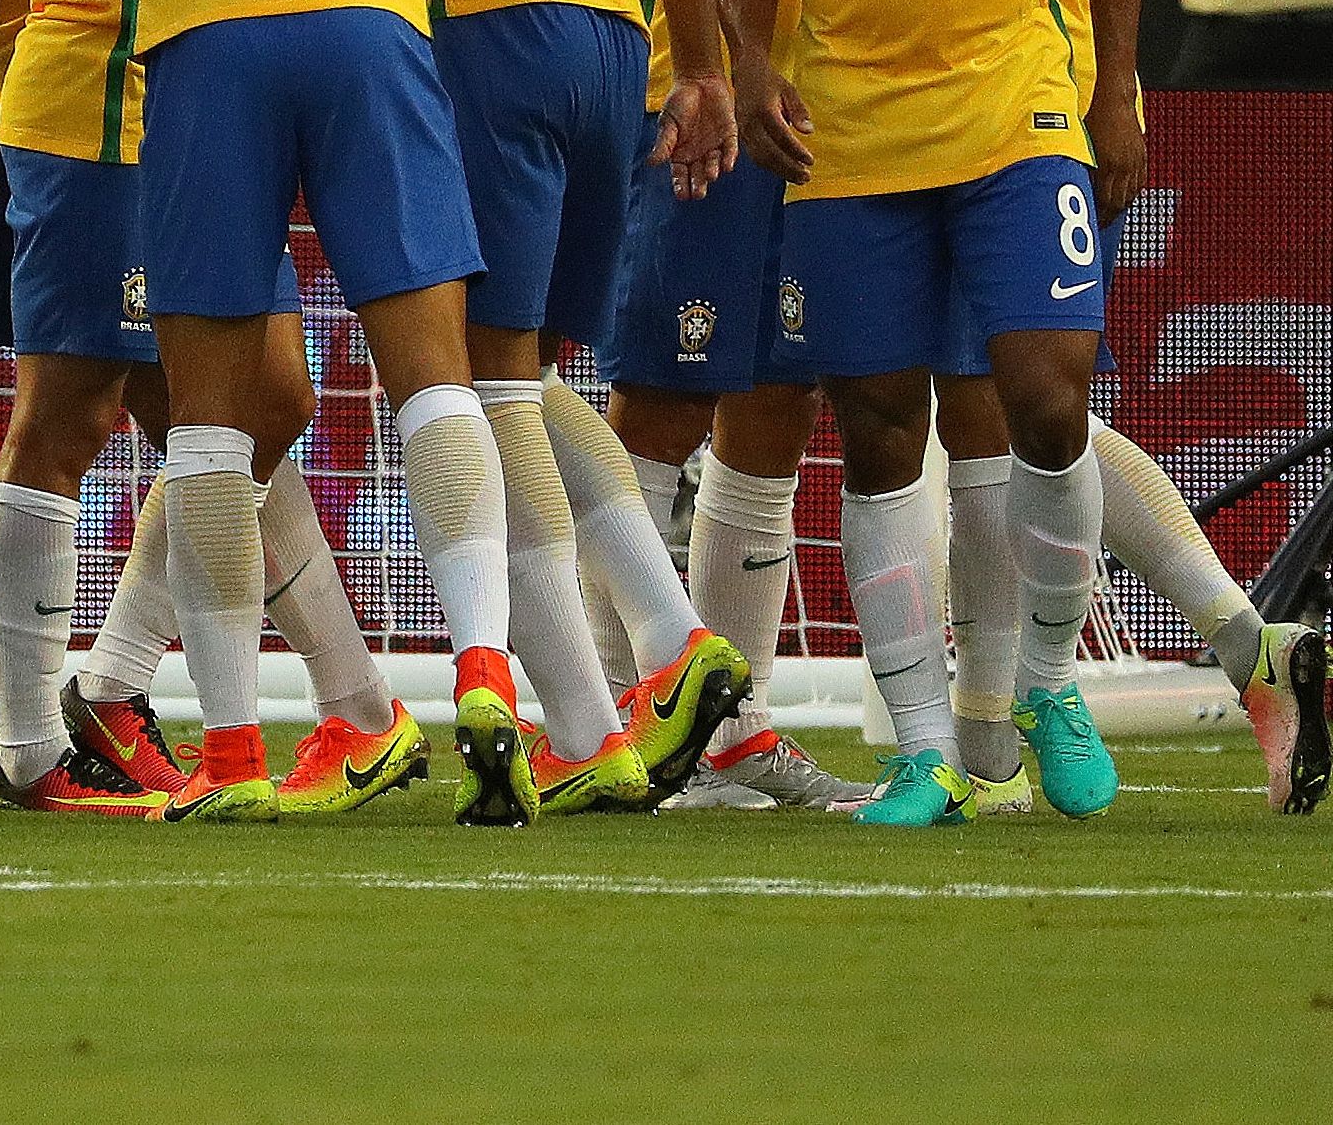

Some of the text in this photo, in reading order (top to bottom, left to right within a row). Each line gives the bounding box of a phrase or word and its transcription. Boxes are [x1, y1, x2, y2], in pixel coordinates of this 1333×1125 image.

[1057, 183, 1096, 266] 8
[120, 321, 153, 332] BRASIL
[677, 353, 708, 362] BRASIL
